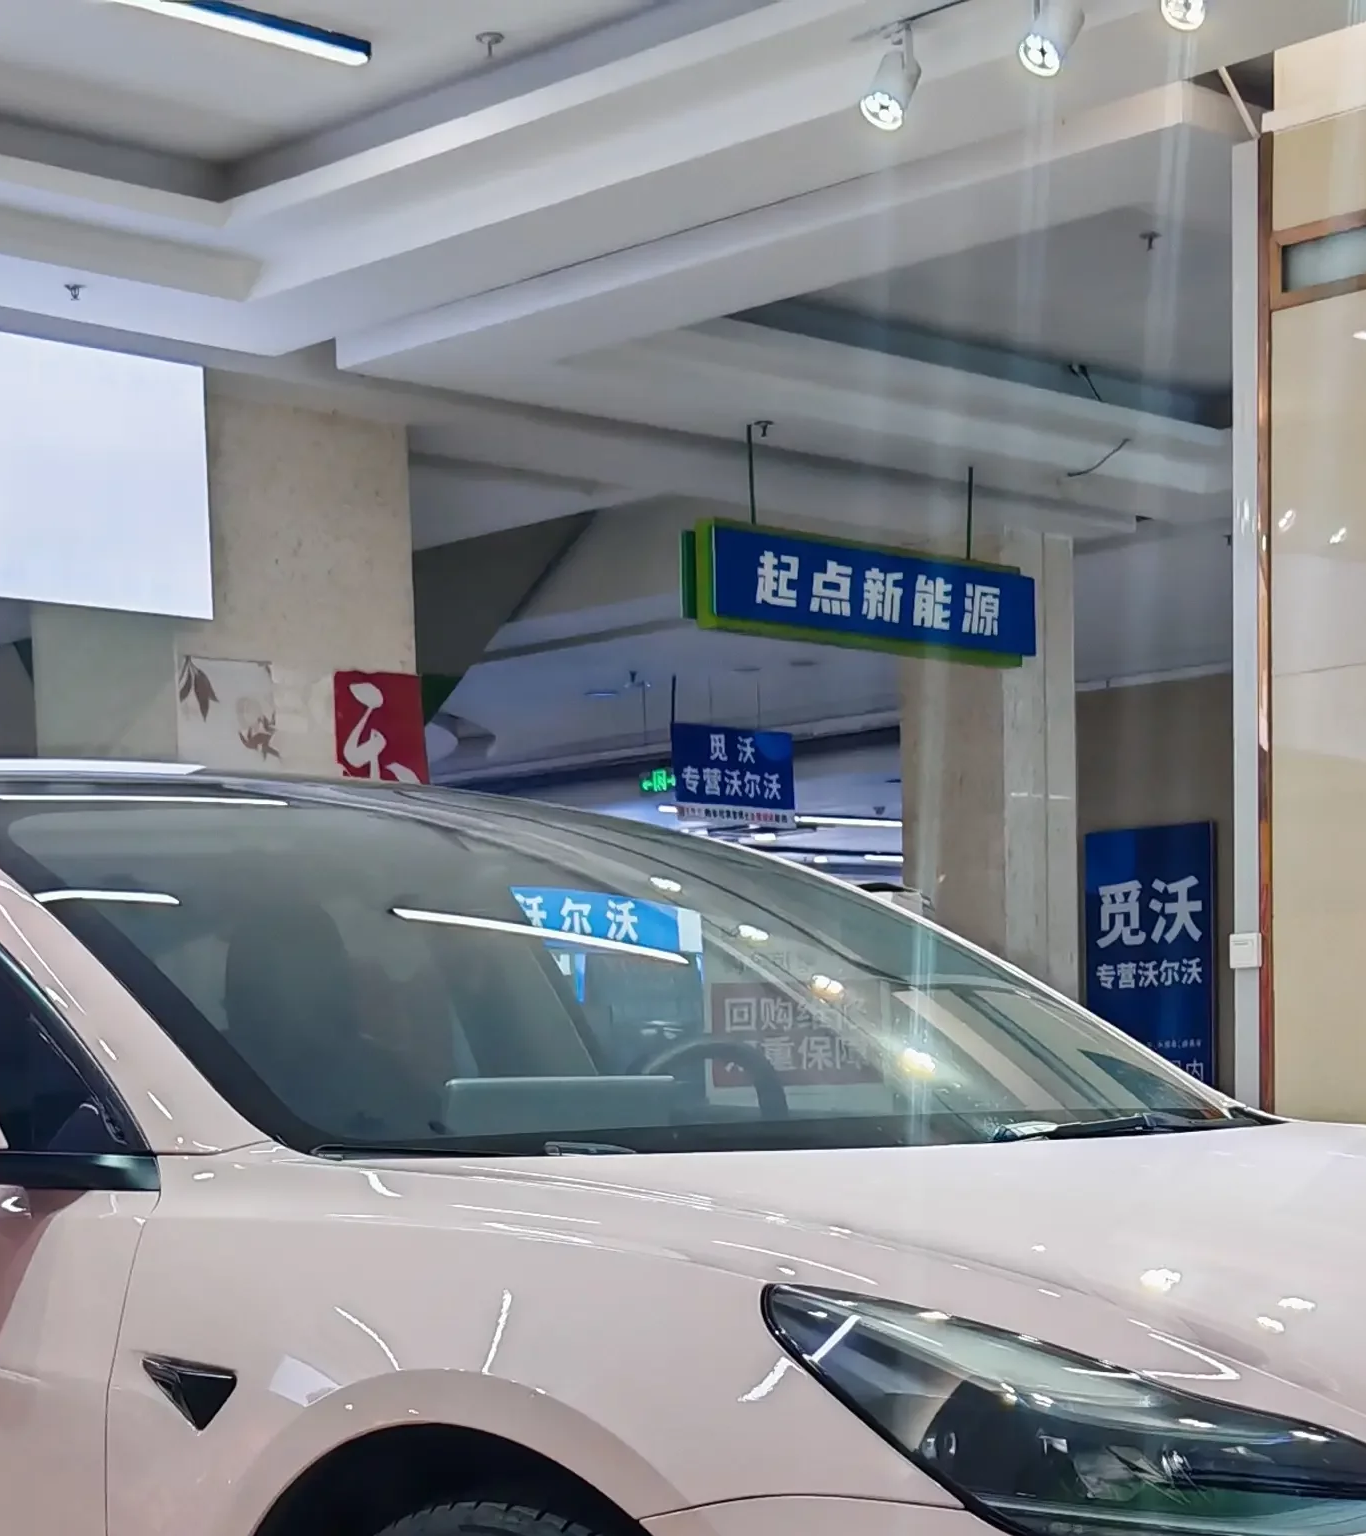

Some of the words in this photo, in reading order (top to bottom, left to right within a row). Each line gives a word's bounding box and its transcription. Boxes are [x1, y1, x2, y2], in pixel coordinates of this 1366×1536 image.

[756, 550, 1001, 636] 起点新能源
[710, 733, 756, 764] 觅沃
[681, 765, 782, 801] 专营沃尔沃
[1095, 875, 1204, 949] 觅沃
[1096, 957, 1203, 990] 专营沃尔沃
